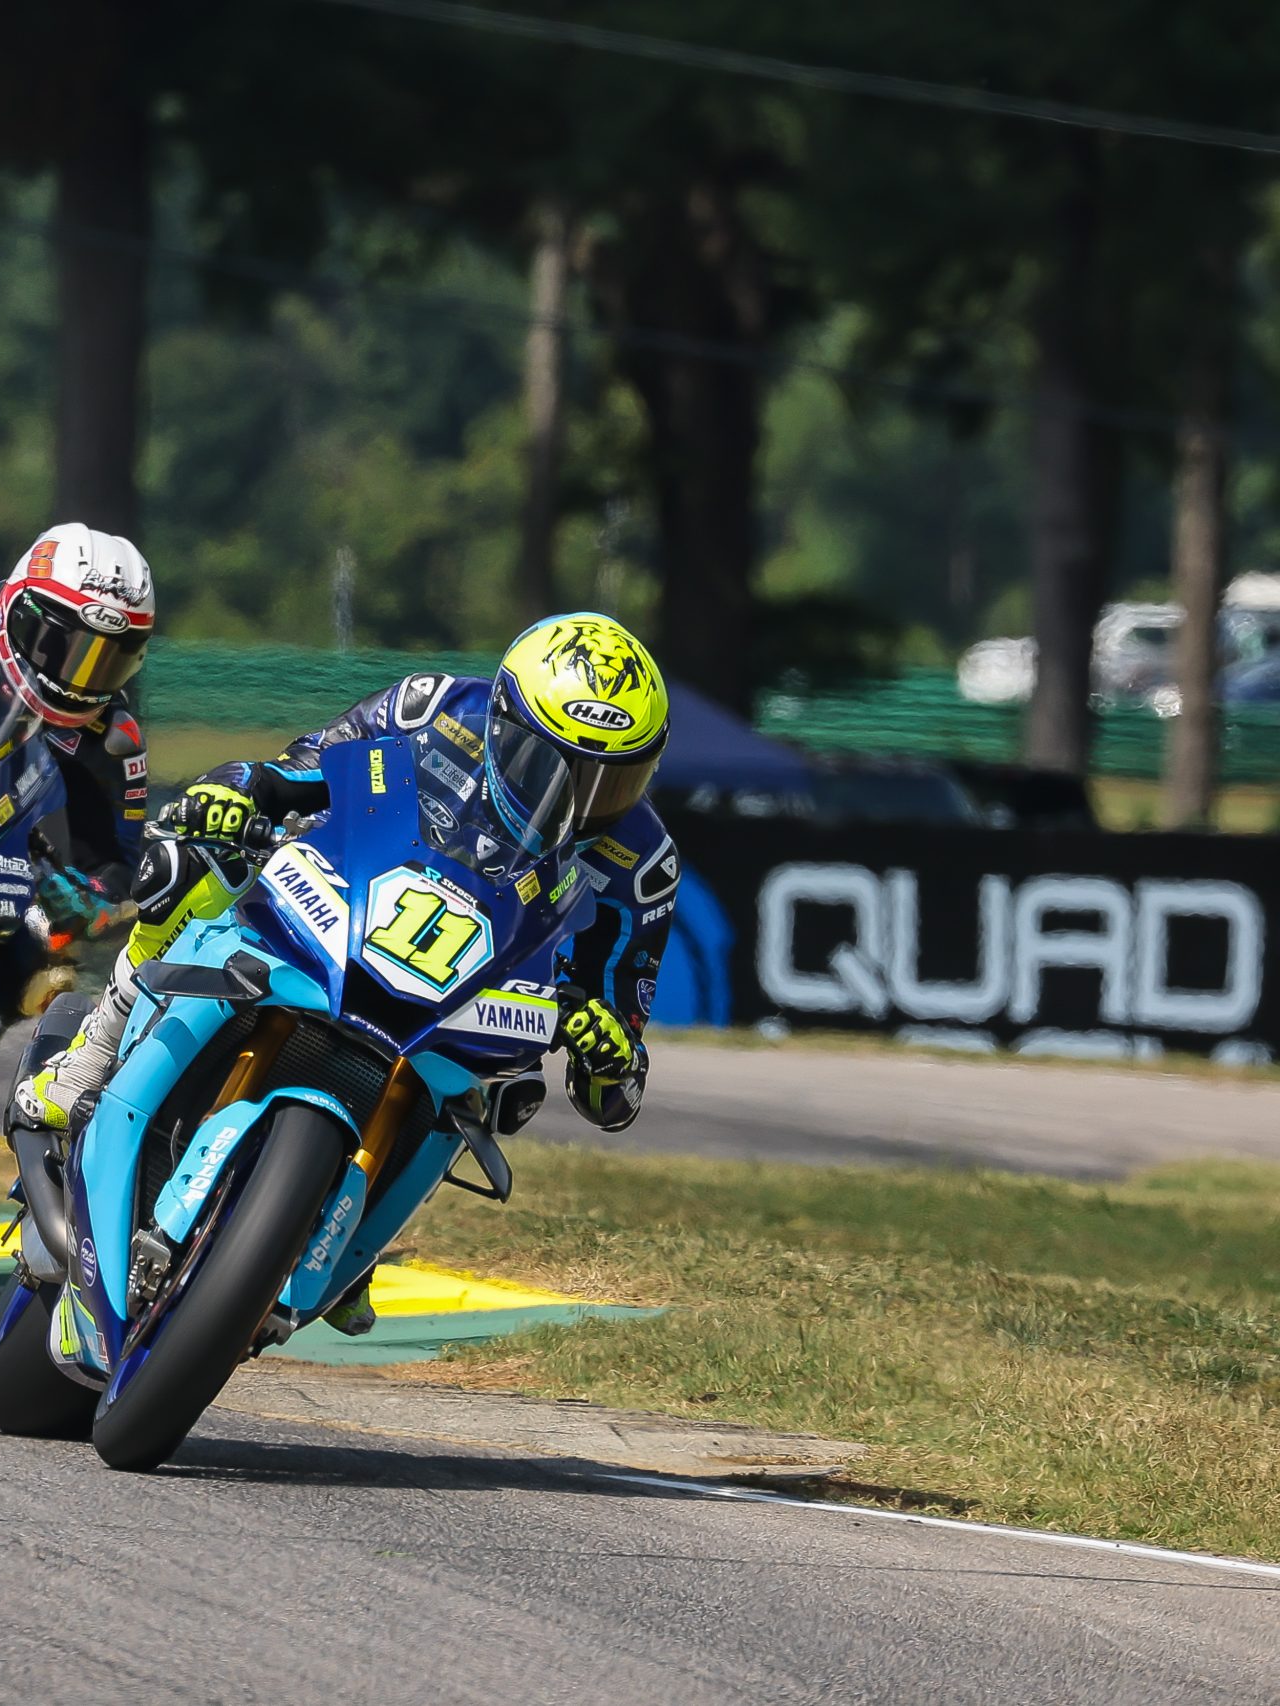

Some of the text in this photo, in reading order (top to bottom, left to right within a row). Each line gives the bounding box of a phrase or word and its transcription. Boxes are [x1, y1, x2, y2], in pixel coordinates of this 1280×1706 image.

[81, 606, 126, 629] Arai
[570, 703, 628, 727] HJC
[274, 862, 340, 934] YAMAHA
[365, 888, 482, 993] 11
[757, 861, 1265, 1032] QUAD
[501, 979, 556, 999] R1
[474, 1001, 547, 1037] YAMAHA
[304, 1093, 349, 1123] YAMAHA
[181, 1126, 239, 1203] DUNLOP
[304, 1195, 353, 1272] DUNLOP
